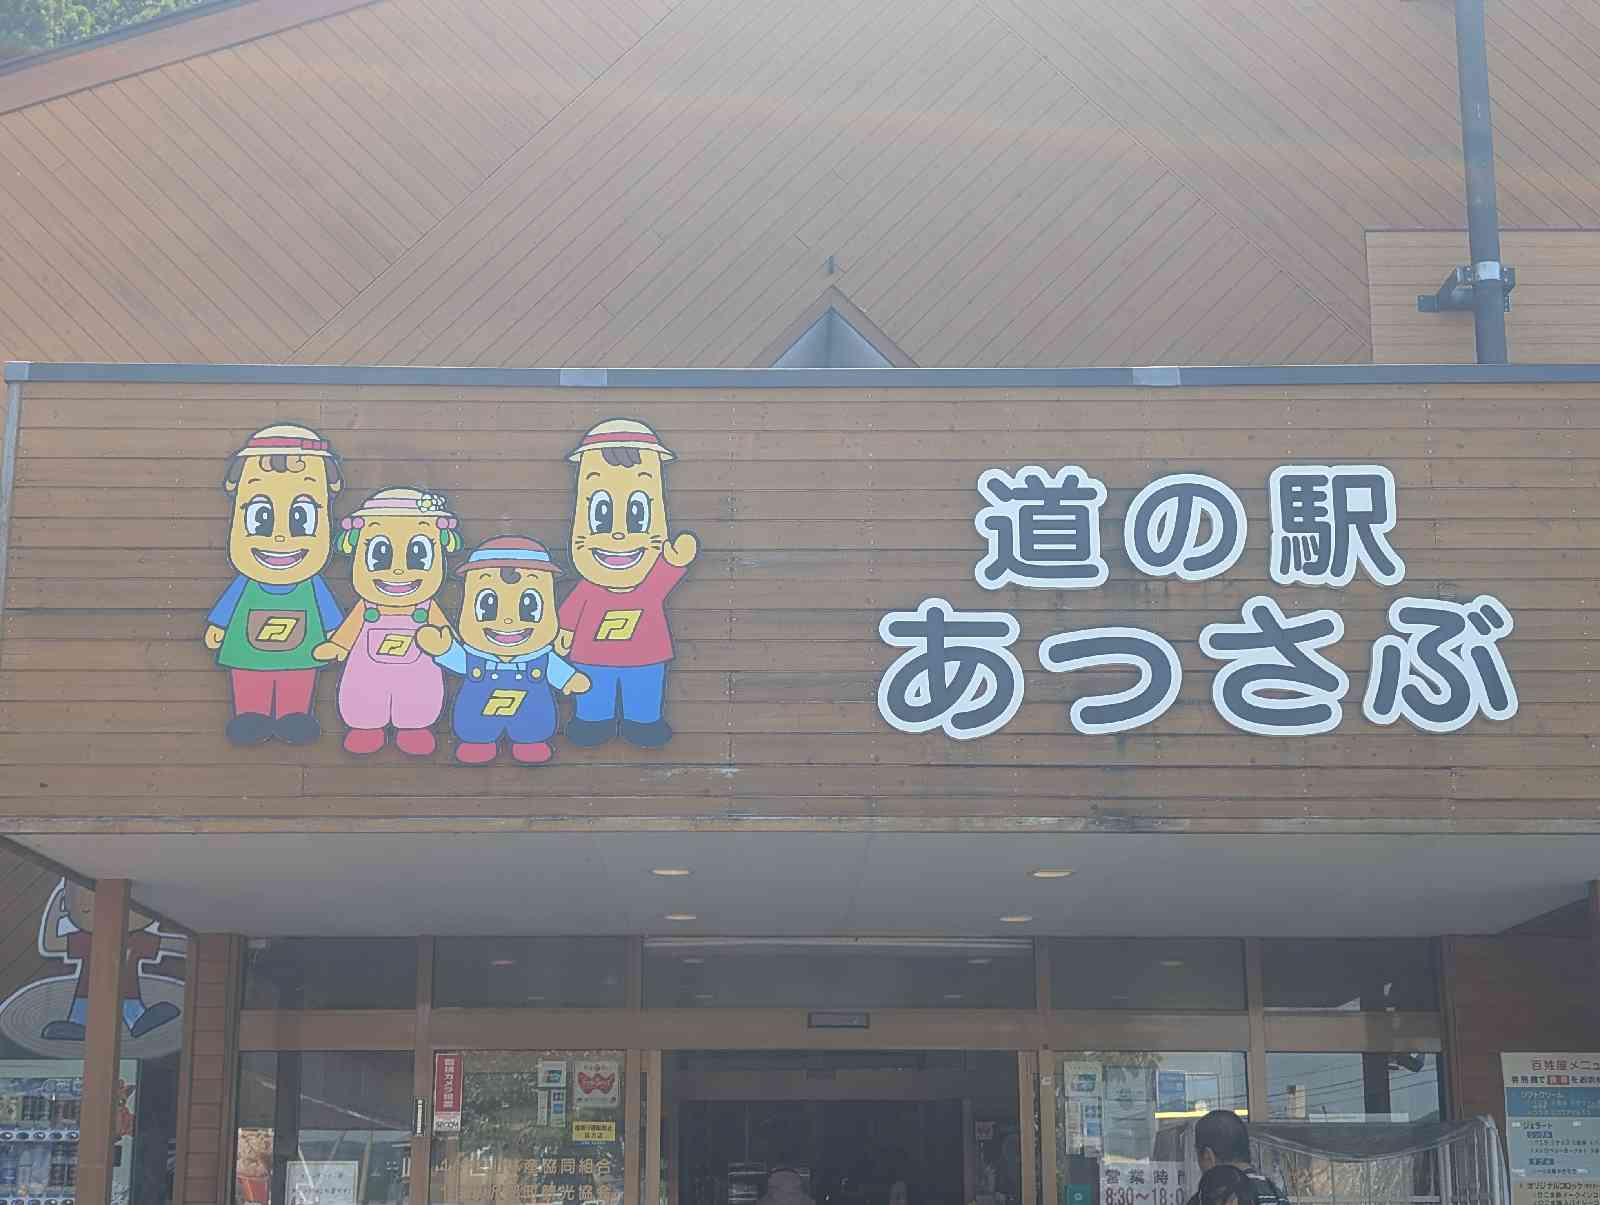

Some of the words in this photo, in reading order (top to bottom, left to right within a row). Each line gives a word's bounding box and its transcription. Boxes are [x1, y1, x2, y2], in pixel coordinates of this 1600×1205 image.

[977, 466, 1405, 588] 道の駅
[879, 596, 1518, 739] あっさぶ
